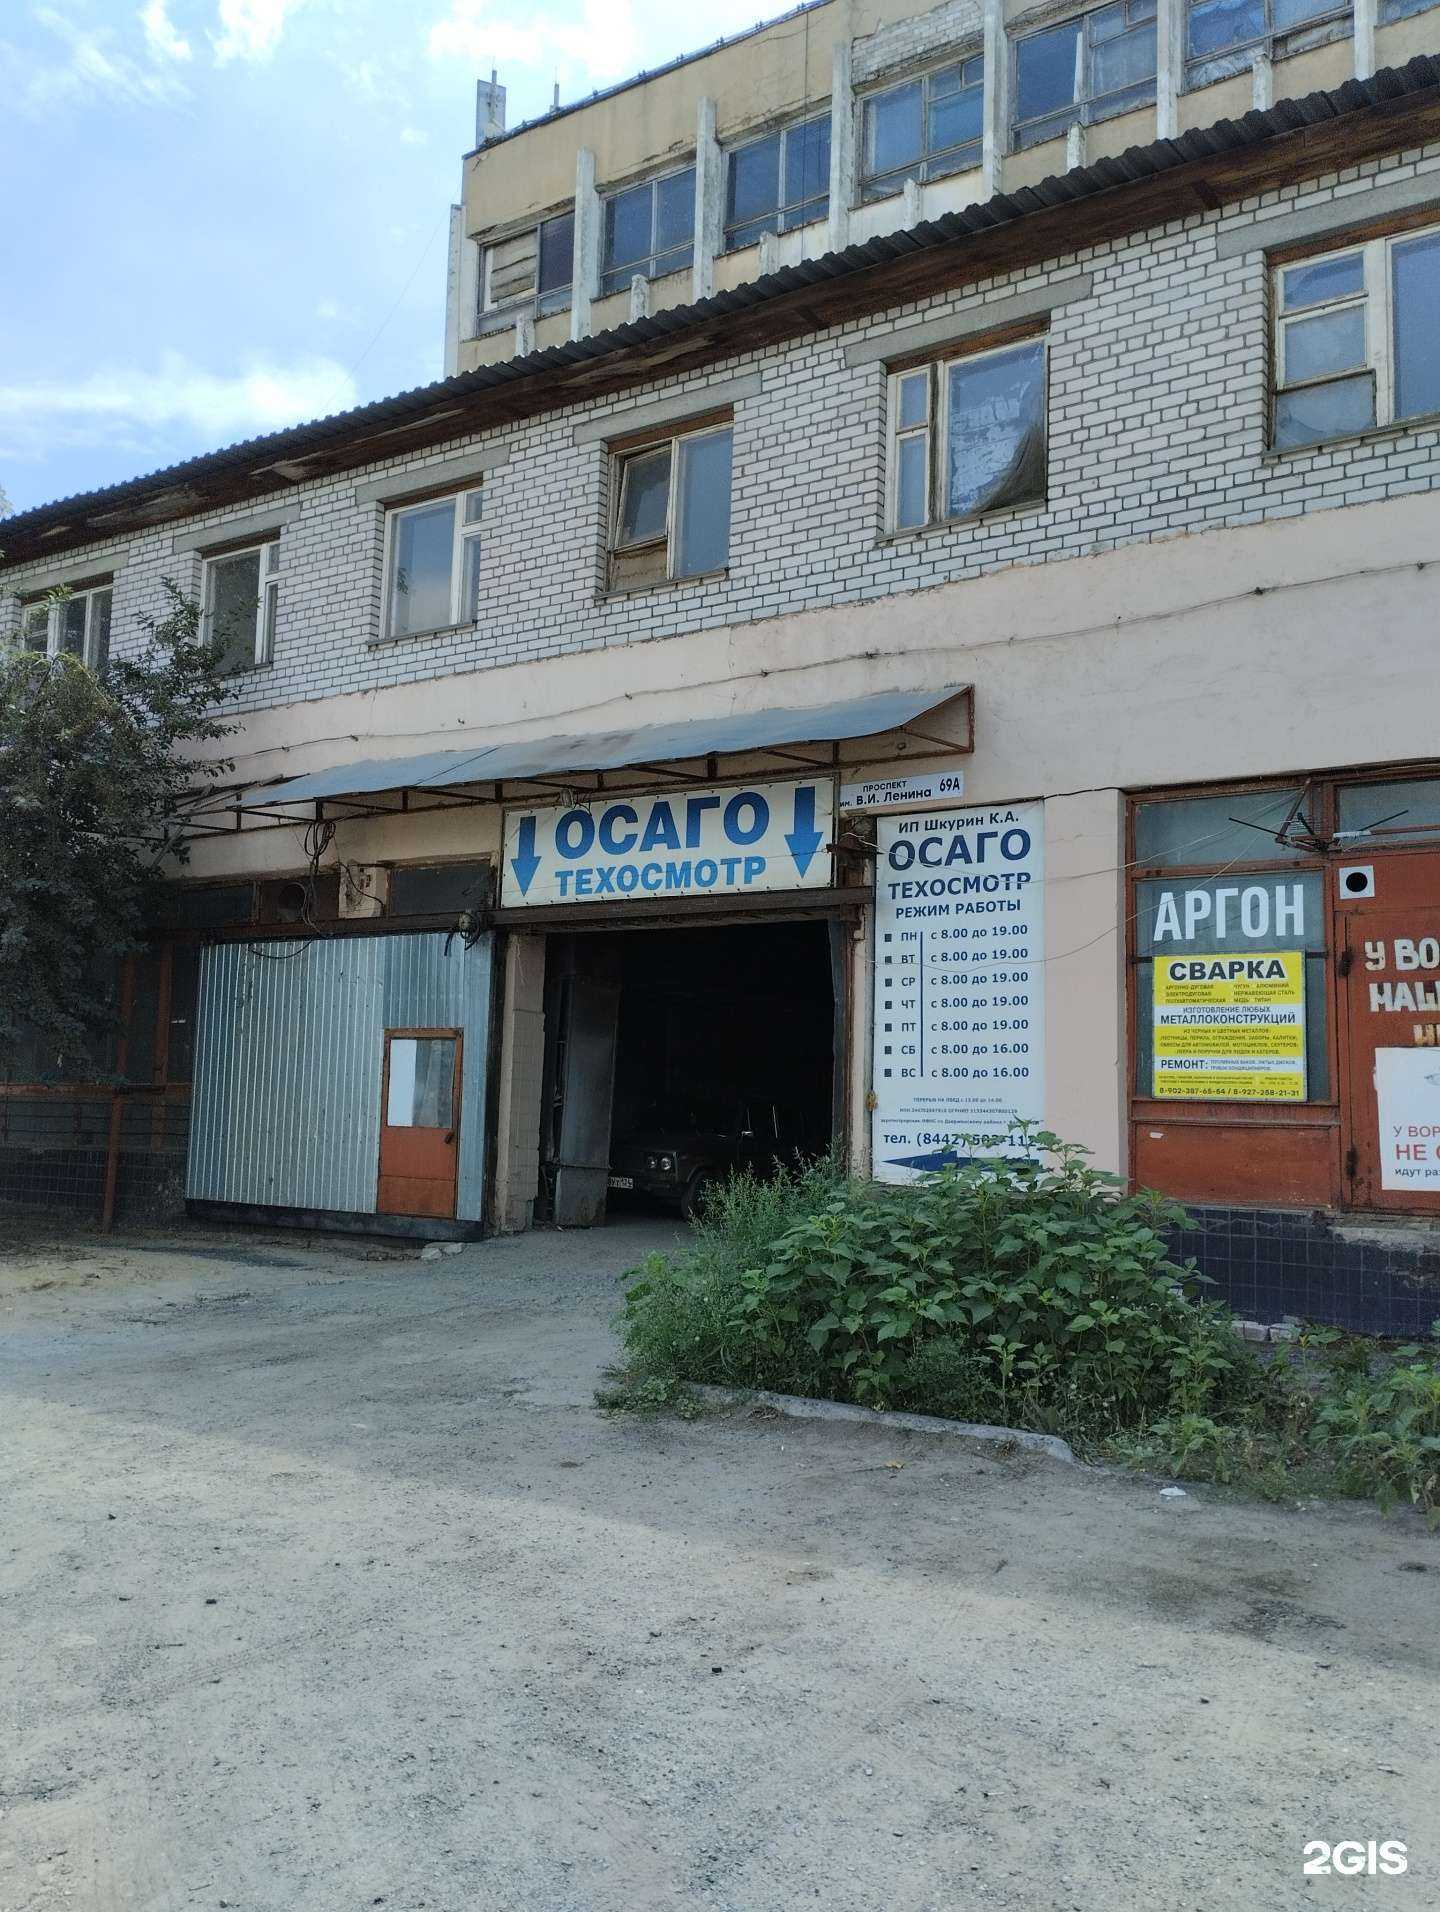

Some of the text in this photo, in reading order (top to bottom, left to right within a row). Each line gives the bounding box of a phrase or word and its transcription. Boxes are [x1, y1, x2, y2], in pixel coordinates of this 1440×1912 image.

[863, 780, 908, 793] ПРОСПЕКТ
[939, 777, 960, 792] 69А
[856, 793, 880, 806] В.И.
[884, 788, 932, 803] Ленина
[554, 791, 770, 860] ОСАГО
[898, 811, 1019, 834] ИП Шкурин К.А.
[888, 828, 1031, 871] ОСАГО
[554, 855, 767, 897] ТЕХОСМОТР
[888, 872, 1031, 900] ТЕХОСМОТР
[895, 899, 1021, 919] РЕЖИМ РАБОТЫ
[1153, 884, 1305, 942] АРГОН
[901, 924, 1028, 942] ПН с 8.00 до 19.00
[901, 948, 1028, 964] ВТ с 8.00 до 19.00
[1364, 941, 1386, 971] У
[1169, 959, 1286, 981] СВАРКА
[901, 972, 1028, 987] СР с 8.00 до 19.00
[901, 995, 1028, 1009] ЧТ с 8.00 до 19.00
[1183, 1006, 1239, 1014] ИЗГОТОВЛЕНИЕ
[901, 1019, 1028, 1032] ПТ с 8.00 до 19.00
[1161, 1012, 1296, 1025] МЕТАЛЛОКОНСТРУКЦИЙ
[901, 1043, 1028, 1055] СБ с 8.00 до 16.00
[1161, 1059, 1208, 1070] РЕМОНТ:
[901, 1067, 1028, 1078] ВС с 8.00 до 16.00
[1393, 1125, 1402, 1137] У
[884, 1134, 911, 1144] тел.
[1396, 1144, 1428, 1160] НЕ
[1395, 1168, 1421, 1178] идут
